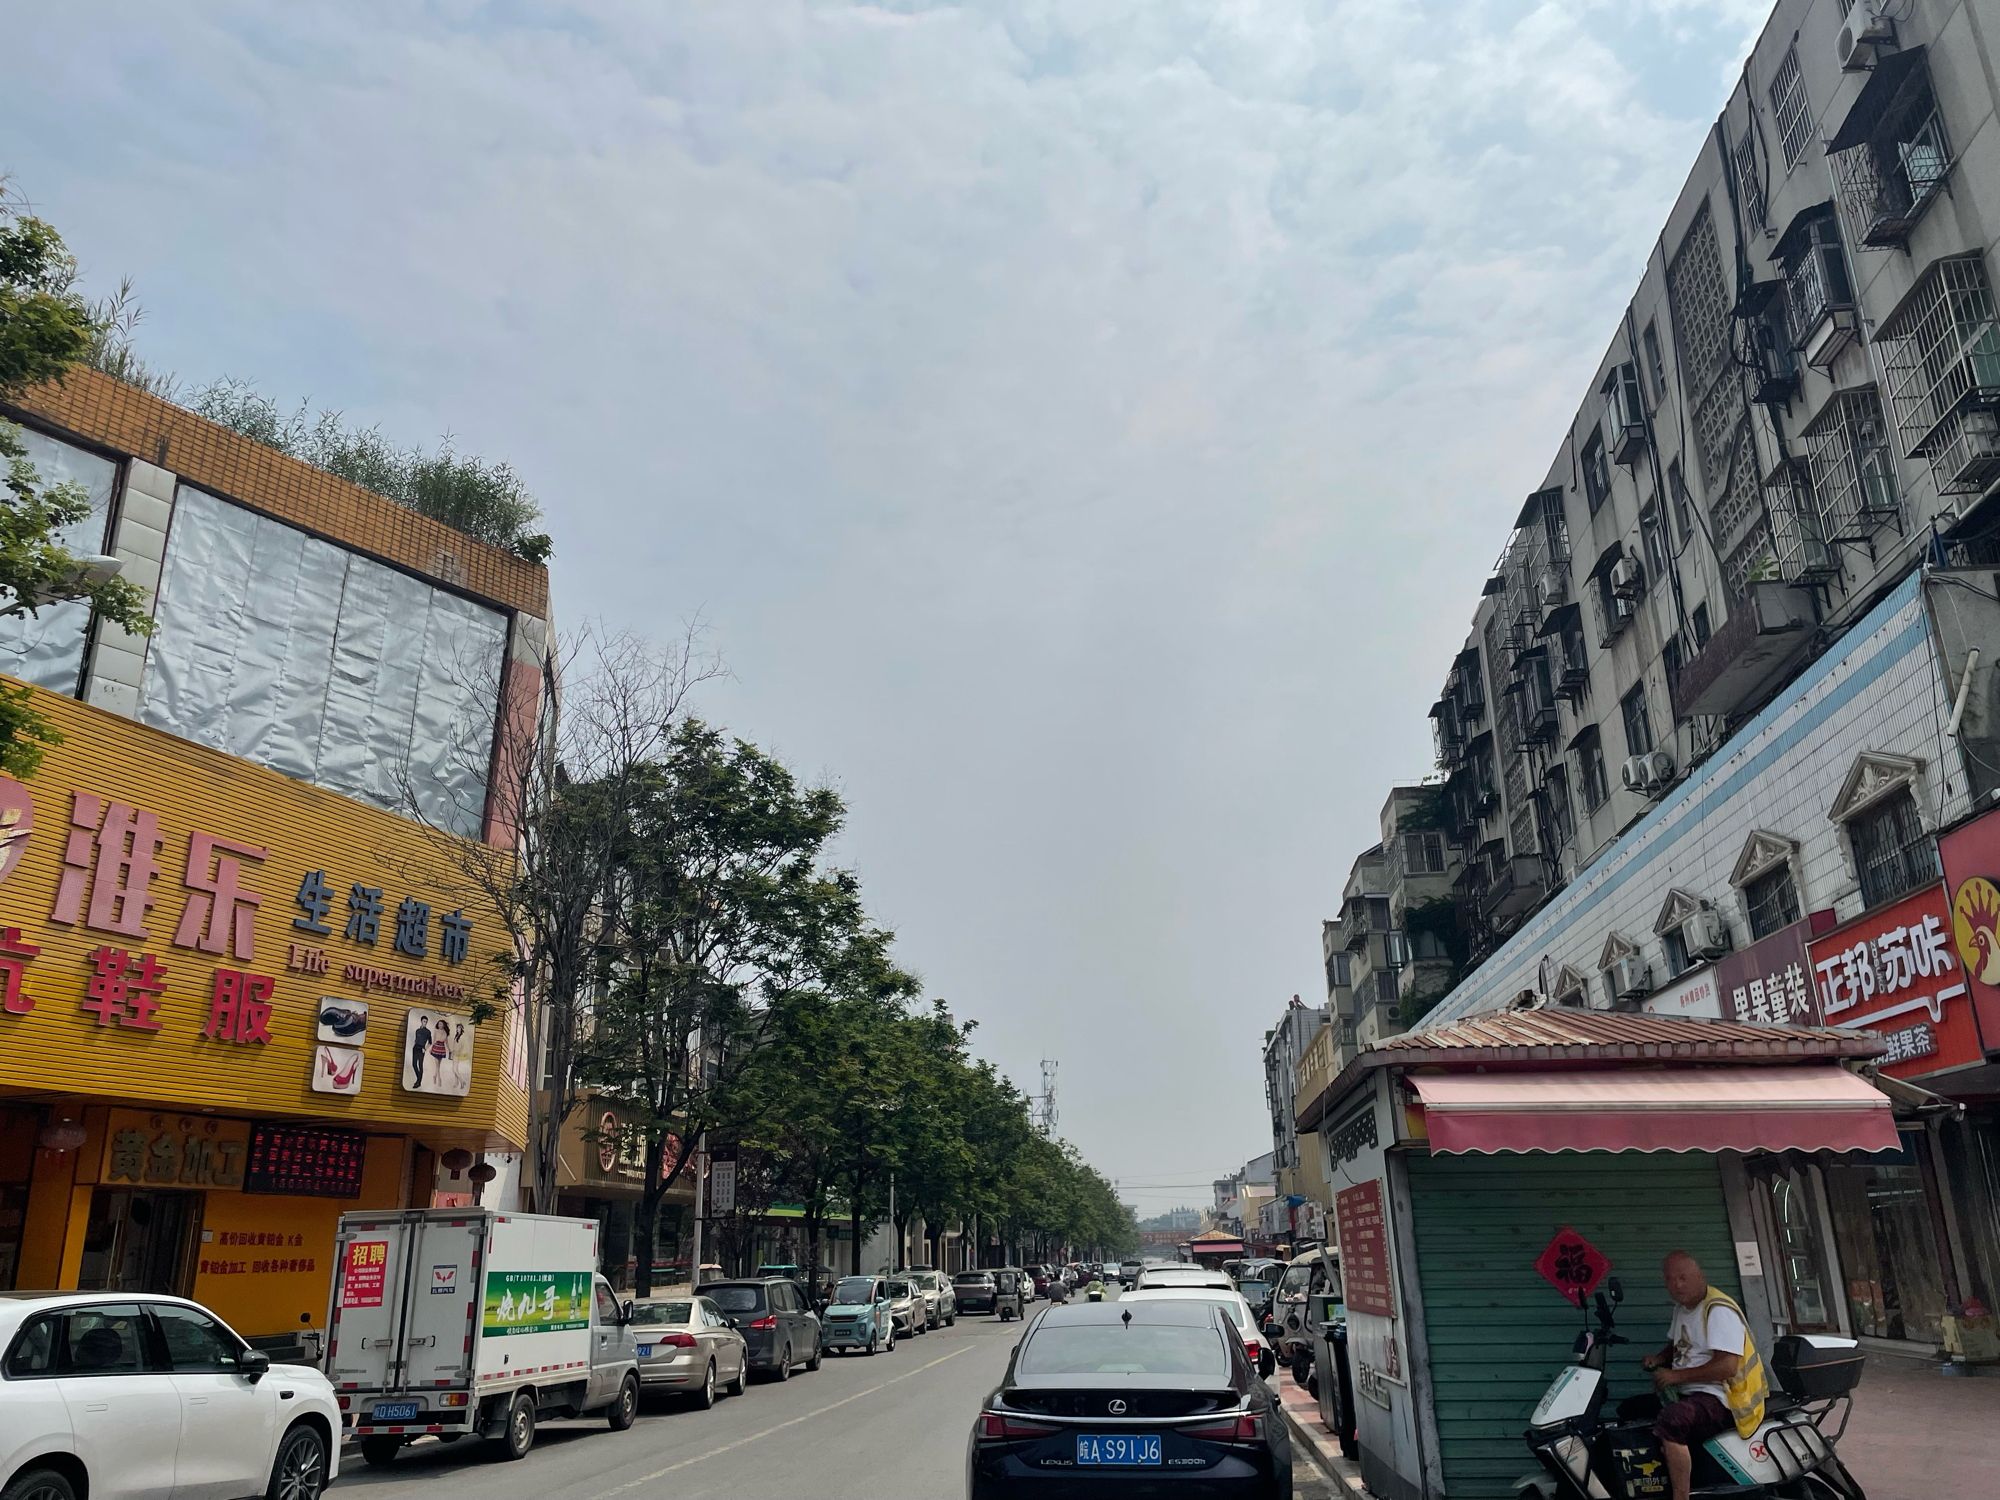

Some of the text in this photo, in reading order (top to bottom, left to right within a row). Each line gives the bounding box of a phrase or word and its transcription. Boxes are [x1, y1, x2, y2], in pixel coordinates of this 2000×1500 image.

[49, 789, 271, 961] 淮乐
[293, 870, 474, 963] 生活超市
[1815, 914, 1953, 1016] 正邦苏咔
[108, 1128, 246, 1186] 黄金加工
[352, 1243, 386, 1266] 招聘
[1553, 1243, 1594, 1284] 福
[1040, 1458, 1073, 1466] LEXUS
